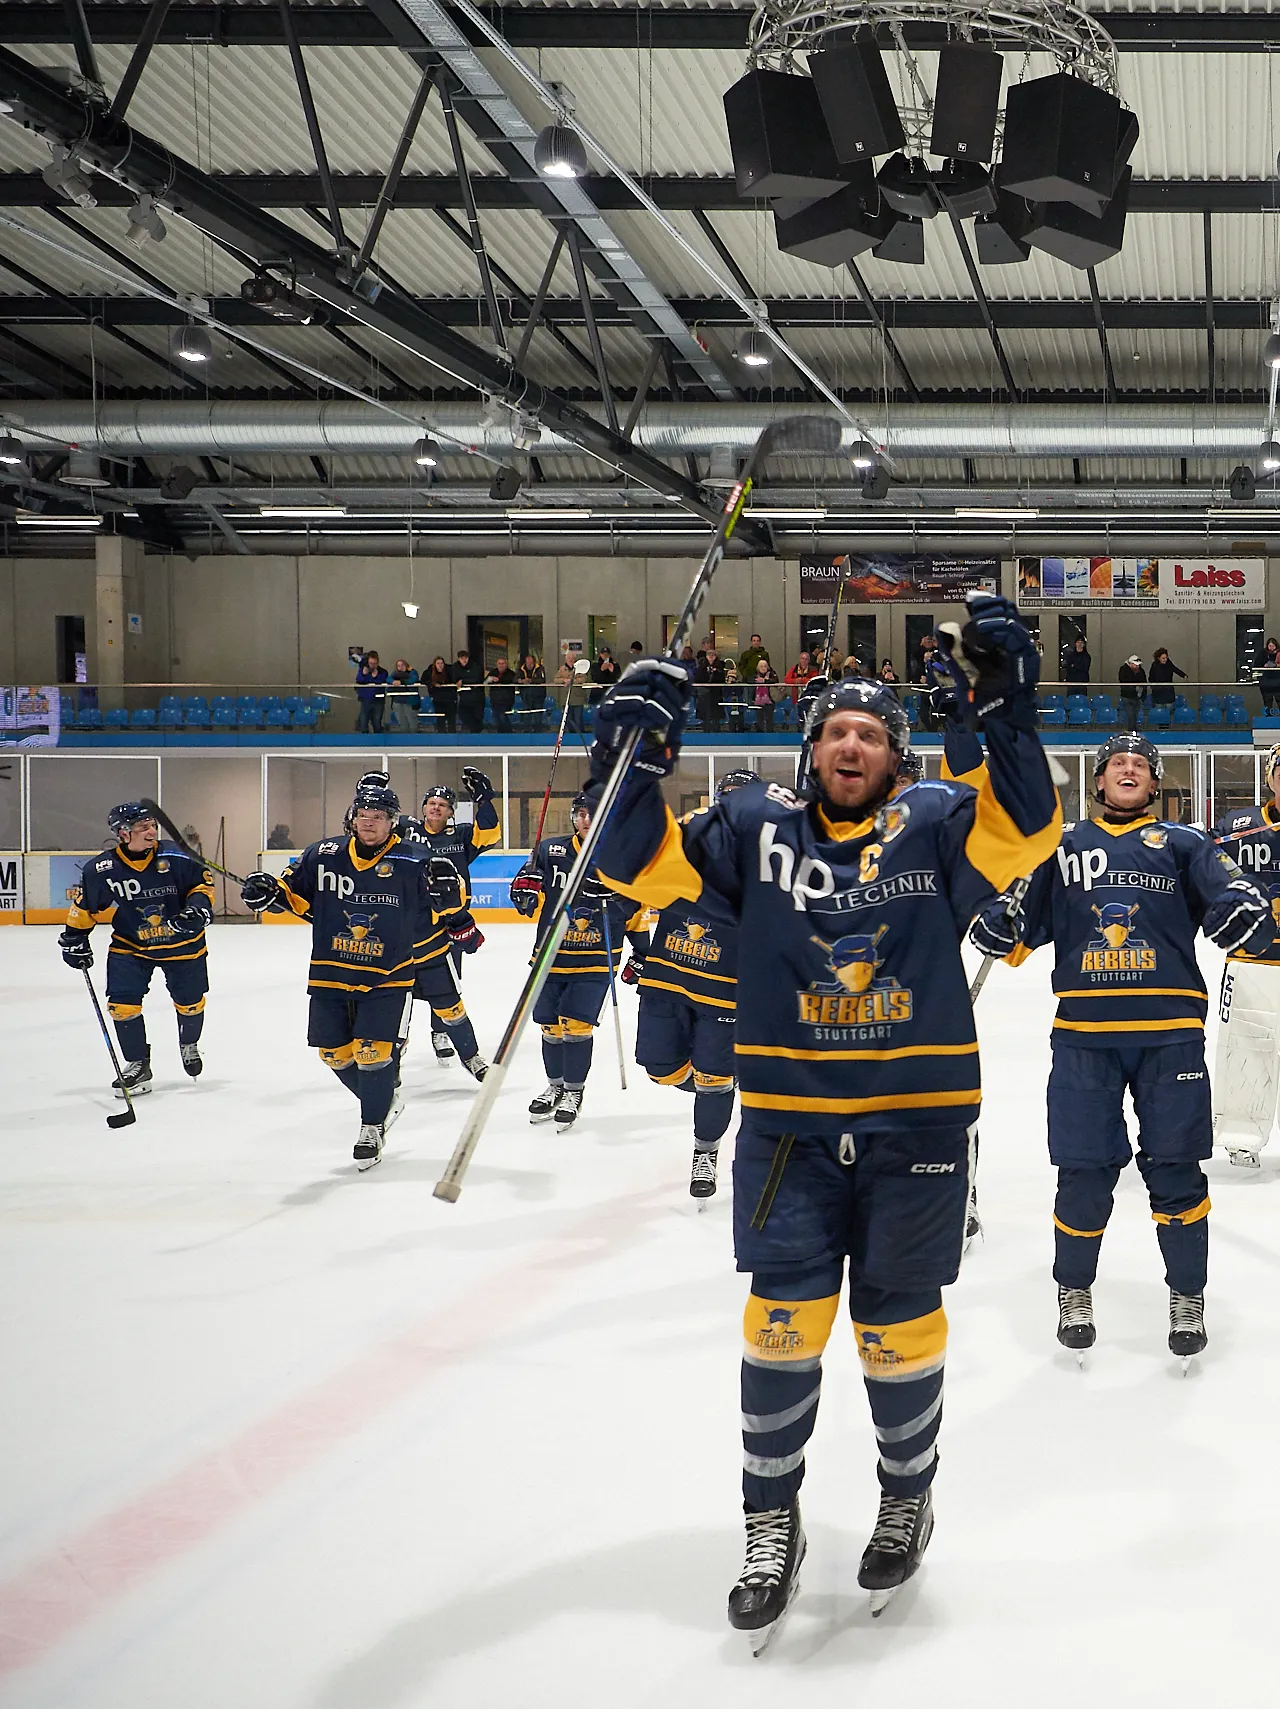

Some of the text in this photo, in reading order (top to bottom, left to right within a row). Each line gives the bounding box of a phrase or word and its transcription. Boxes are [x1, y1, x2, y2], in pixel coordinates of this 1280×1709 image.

[801, 567, 840, 577] BRAUN
[1174, 564, 1245, 588] Laiss
[1019, 598, 1159, 608] Beratung Planung Ausführung Kundendienst
[635, 761, 666, 774] CCM
[759, 821, 937, 911] hp TECHNIK
[858, 843, 884, 883] C
[1238, 840, 1271, 872] hp
[552, 865, 571, 889] h
[1057, 845, 1176, 893] hp TECHNIK
[106, 877, 141, 901] hp
[317, 864, 354, 900] hp
[332, 936, 384, 957] REBELS
[665, 935, 722, 963] REBELS
[671, 952, 708, 968] STUTTGART
[1081, 950, 1157, 972] REBELS
[1090, 972, 1144, 982] STUTTGART
[798, 989, 913, 1025] REBELS
[1221, 975, 1235, 1023] CCM
[814, 1025, 893, 1042] STUTTGART
[1176, 1072, 1204, 1081] CCM
[910, 1163, 956, 1174] CCM
[755, 1332, 804, 1348] REBELS
